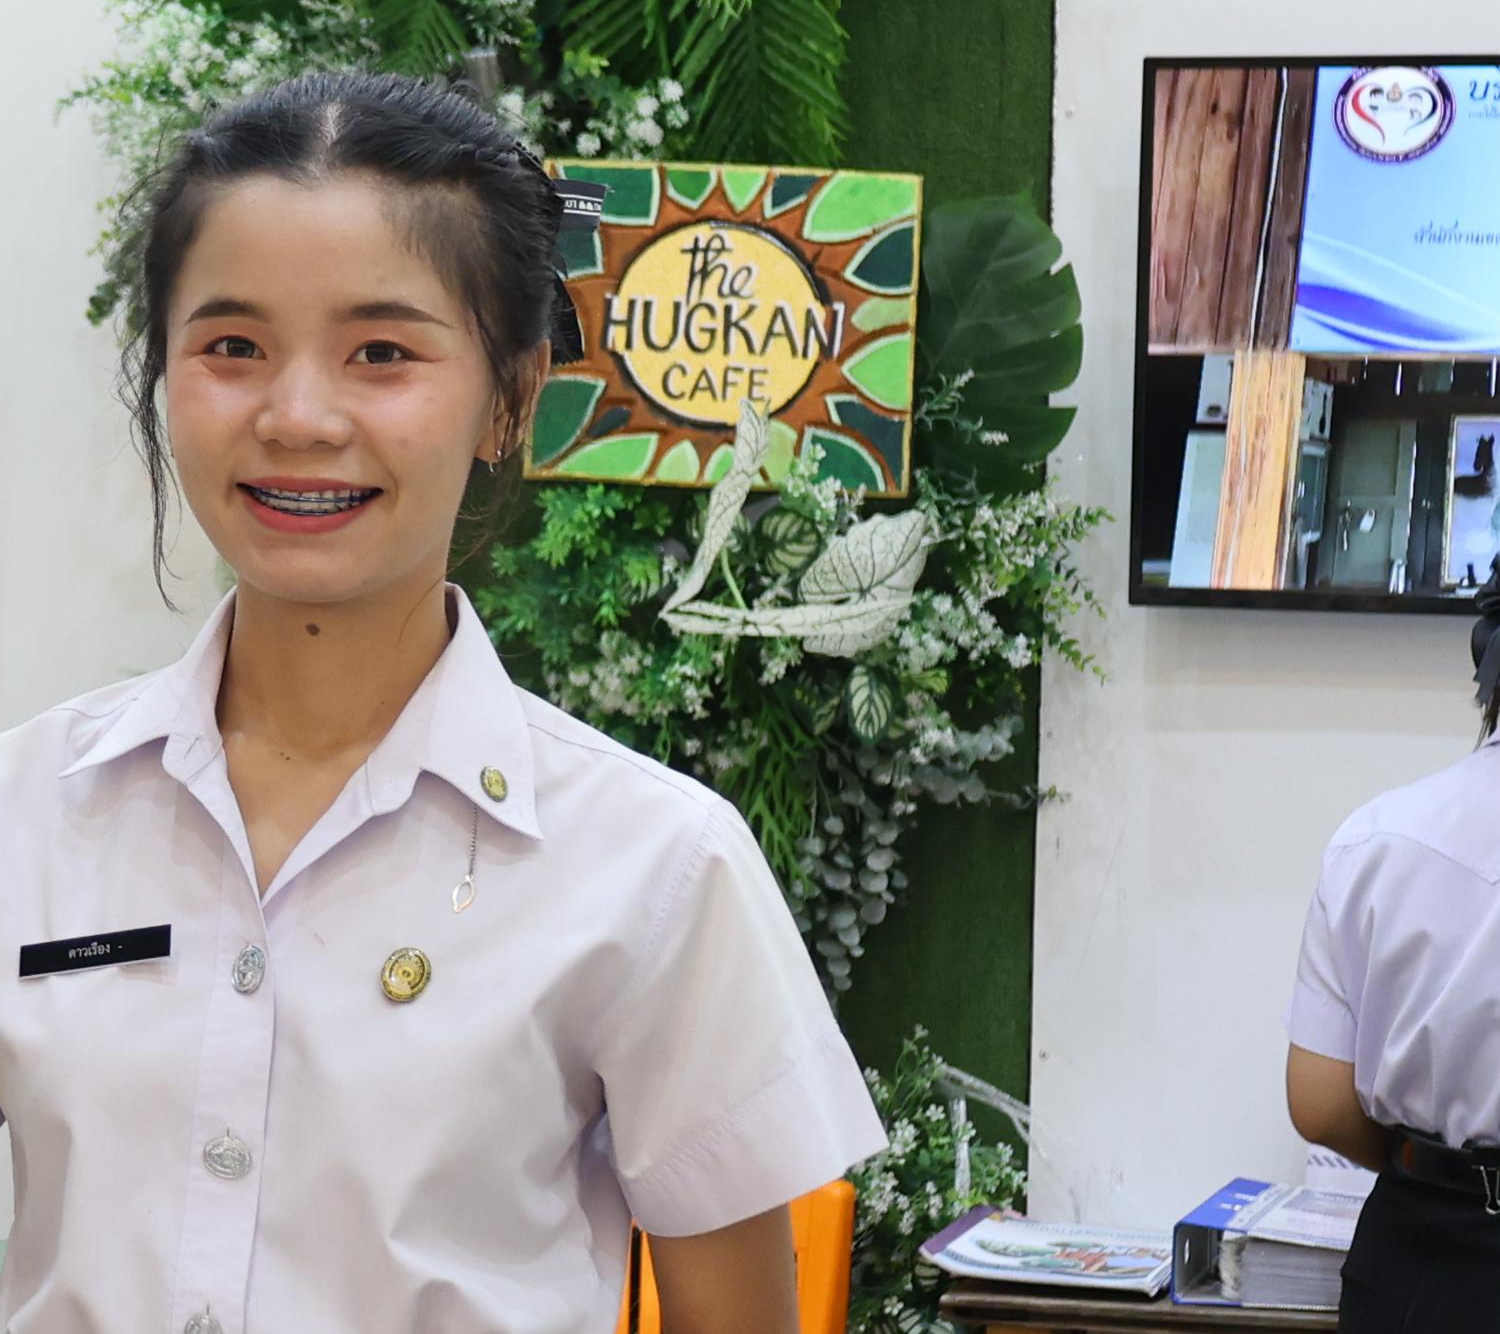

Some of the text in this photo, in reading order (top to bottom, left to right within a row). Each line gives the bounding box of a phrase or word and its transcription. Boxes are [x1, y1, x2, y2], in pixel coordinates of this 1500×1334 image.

[681, 233, 756, 305] the
[604, 295, 845, 360] HUGKAN
[662, 364, 769, 403] CAFE
[68, 942, 110, 959] ดาวเรือง
